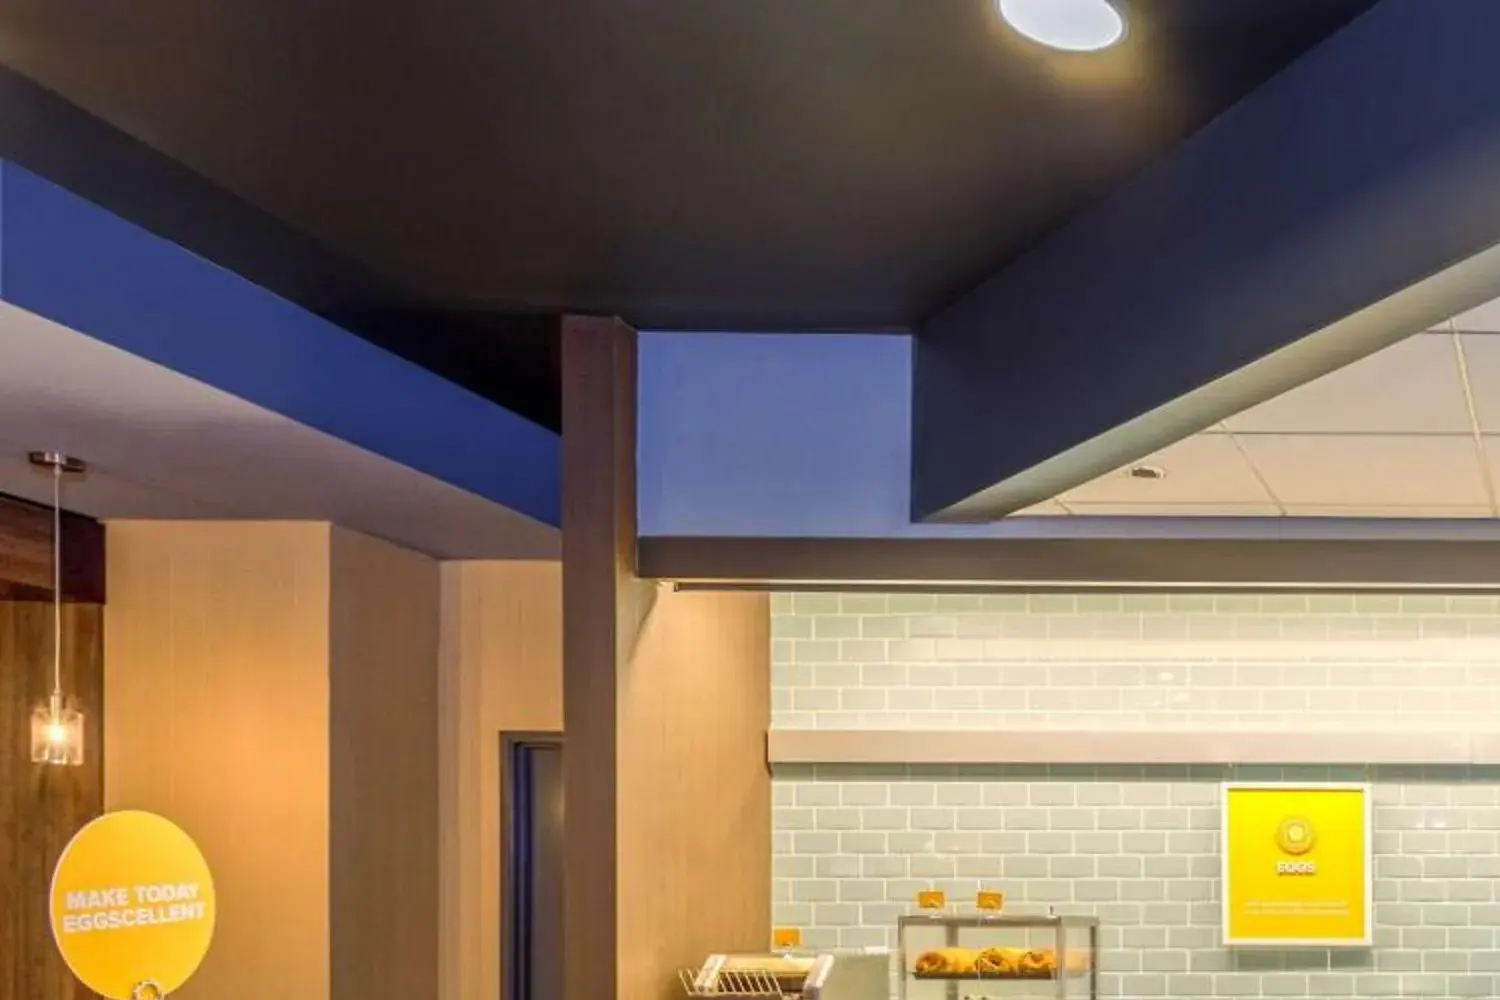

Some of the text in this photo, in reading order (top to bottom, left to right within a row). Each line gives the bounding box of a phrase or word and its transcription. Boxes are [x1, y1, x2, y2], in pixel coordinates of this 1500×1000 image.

[66, 882, 199, 909] MAKE TODAY
[63, 901, 206, 933] EGGSCELLENT
